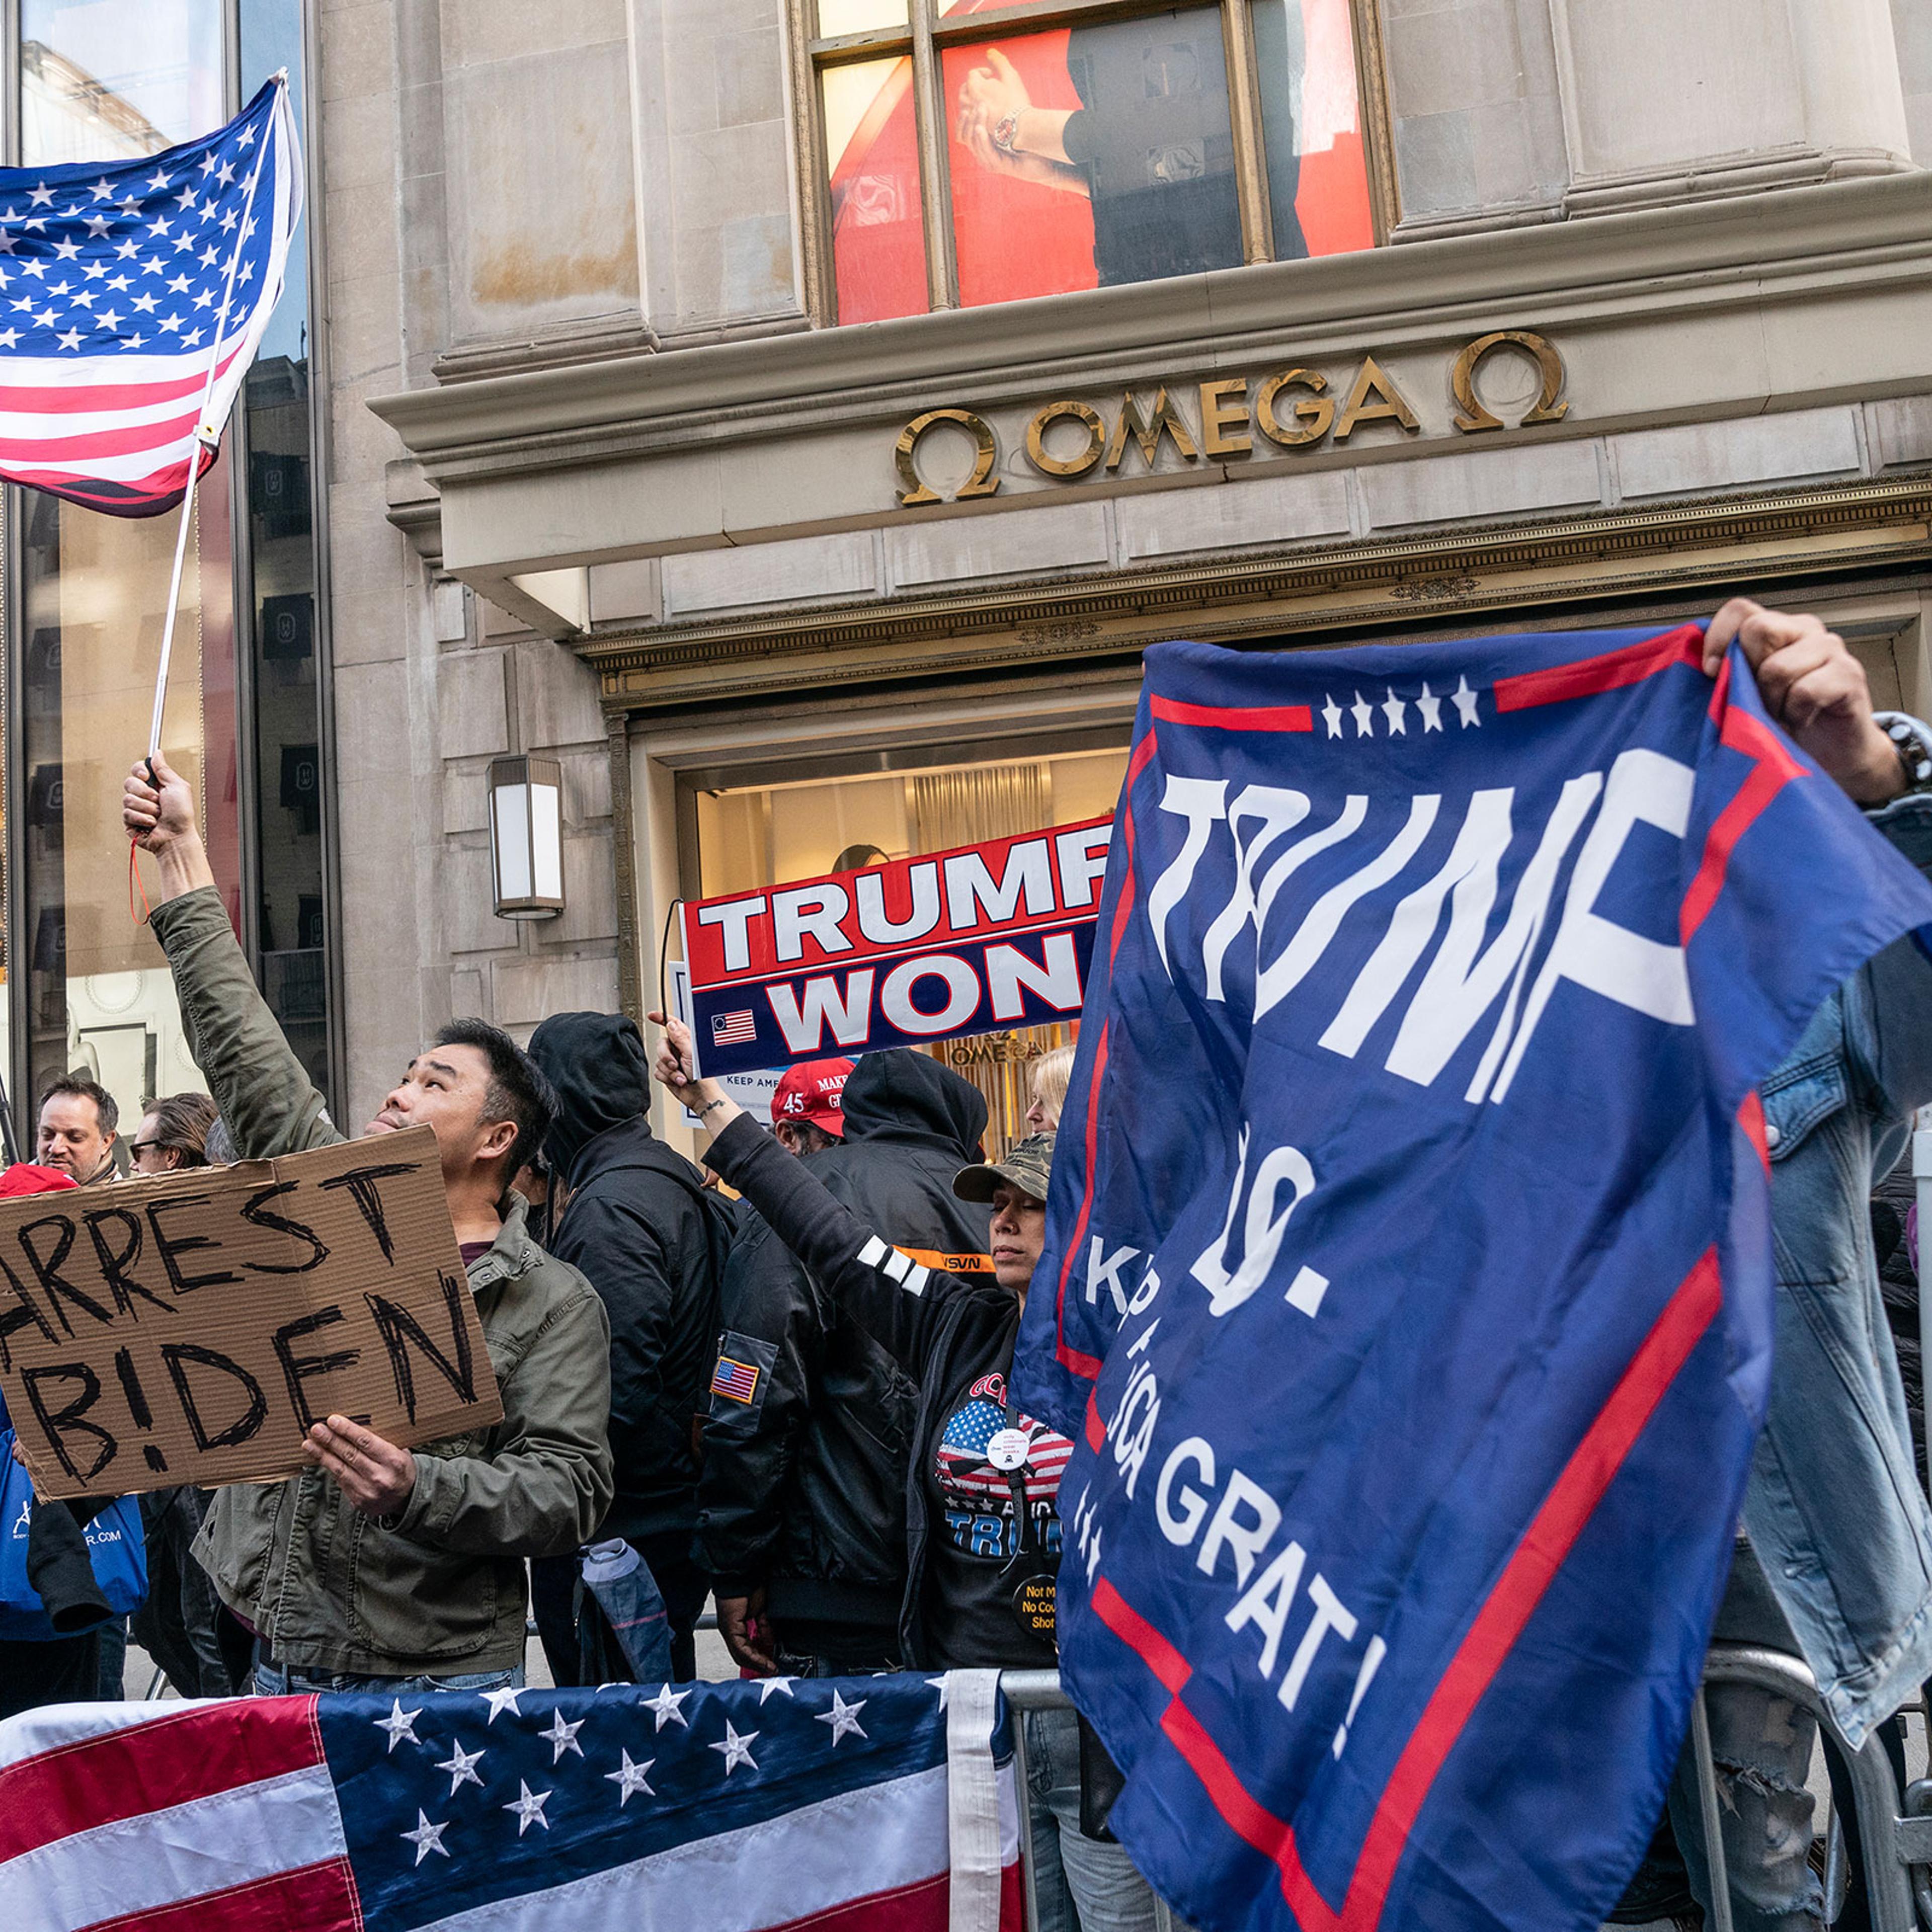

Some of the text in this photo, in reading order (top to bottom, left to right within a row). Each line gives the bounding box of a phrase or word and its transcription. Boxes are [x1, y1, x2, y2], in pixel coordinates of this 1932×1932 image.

[1024, 356, 1420, 479] OMEGA
[699, 824, 1114, 972] TRUMP
[765, 931, 1083, 1055] WON
[951, 1040, 1043, 1066] OMEGA
[727, 1076, 754, 1086] KEEP
[783, 1092, 804, 1114] 45
[0, 1163, 422, 1374] ARREST
[85, 1530, 122, 1546] R.COM
[1026, 1585, 1056, 1598] Not M
[1022, 1600, 1037, 1613] No
[1032, 1616, 1055, 1629] Shot
